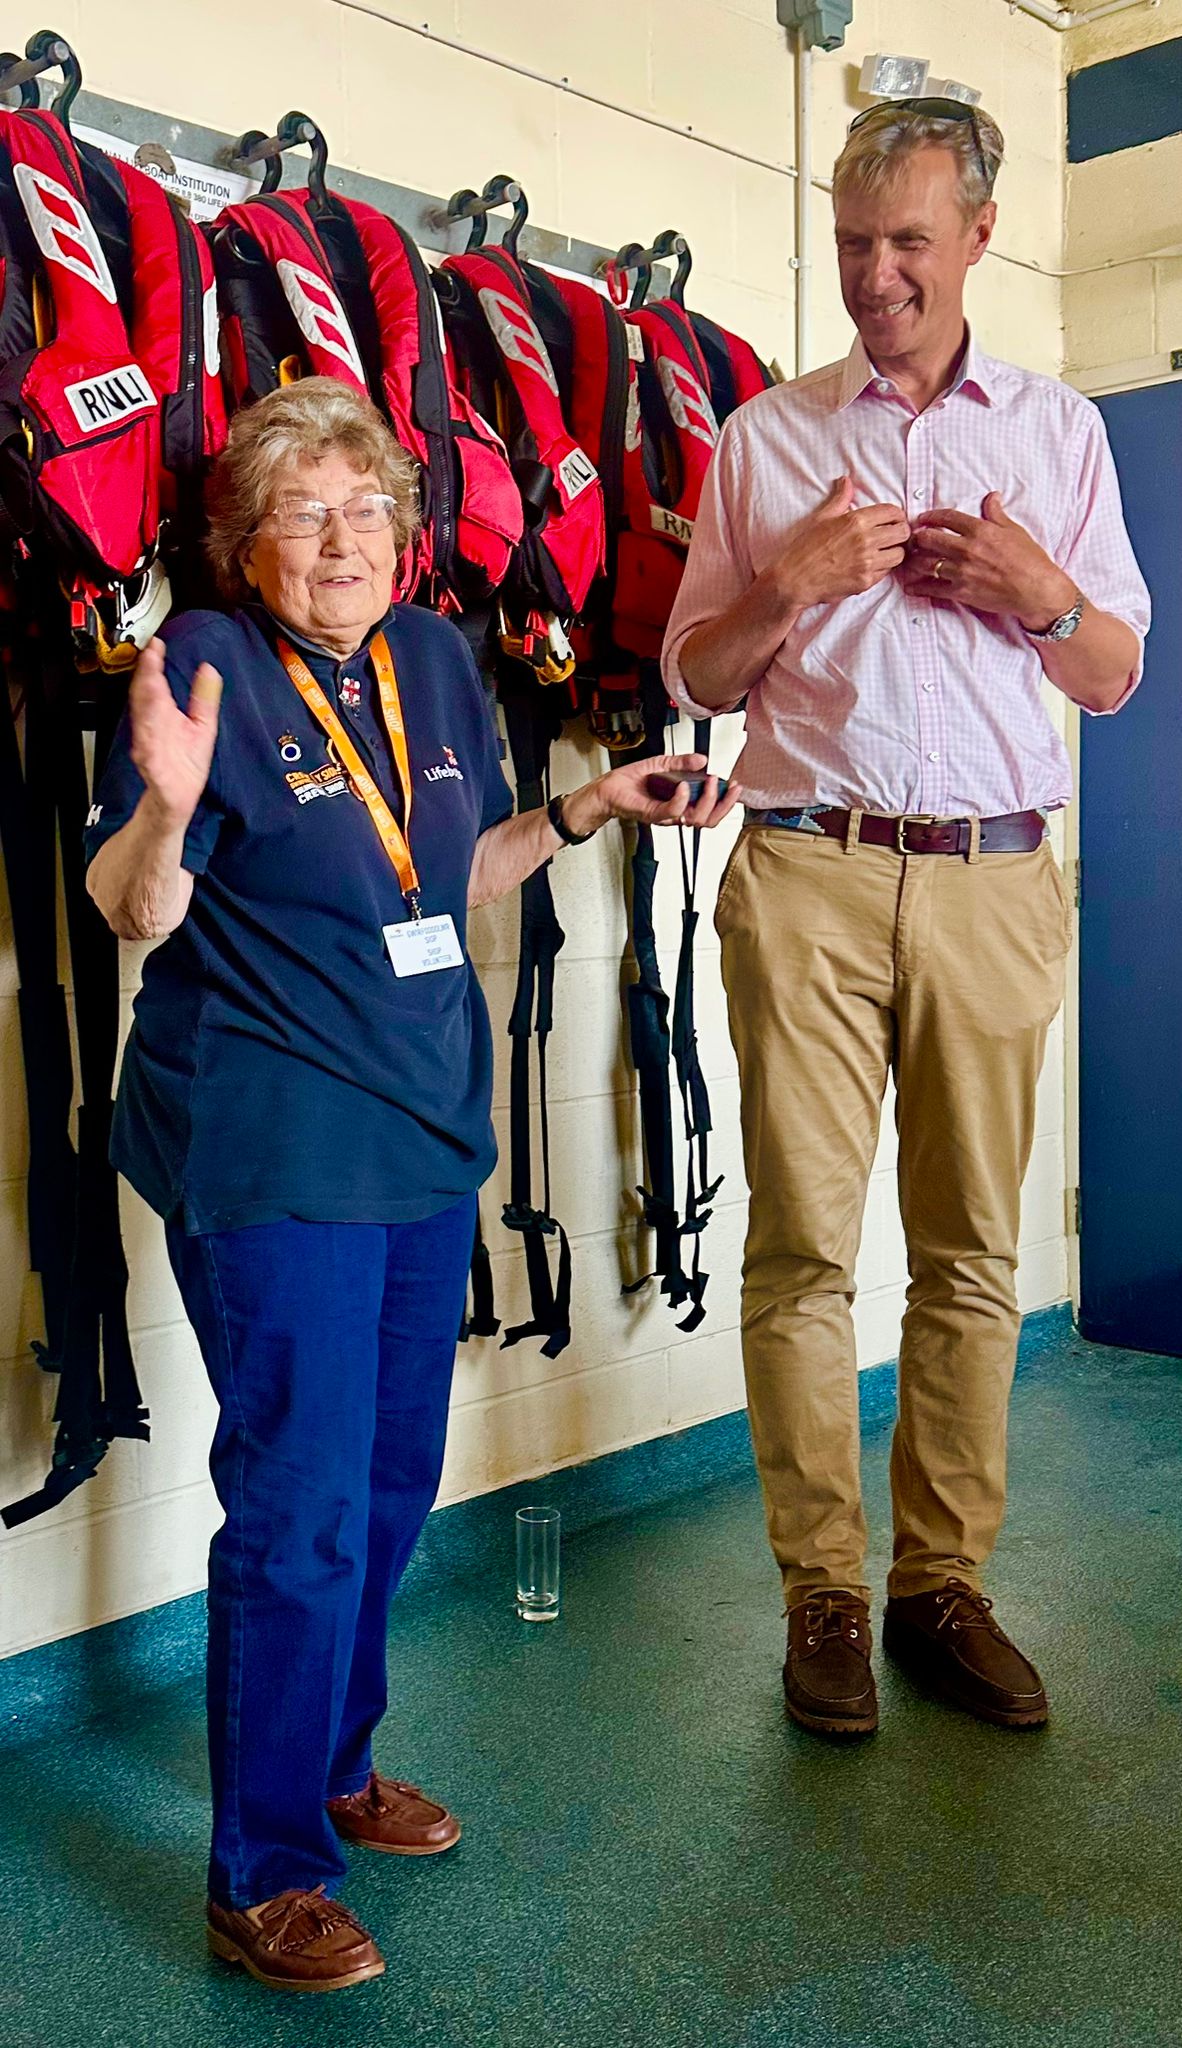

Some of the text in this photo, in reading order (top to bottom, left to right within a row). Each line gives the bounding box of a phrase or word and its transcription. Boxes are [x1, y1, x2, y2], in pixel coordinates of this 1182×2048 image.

[171, 174, 231, 199] INSTITUTION
[79, 372, 148, 423] RNLI
[664, 511, 692, 539] RN
